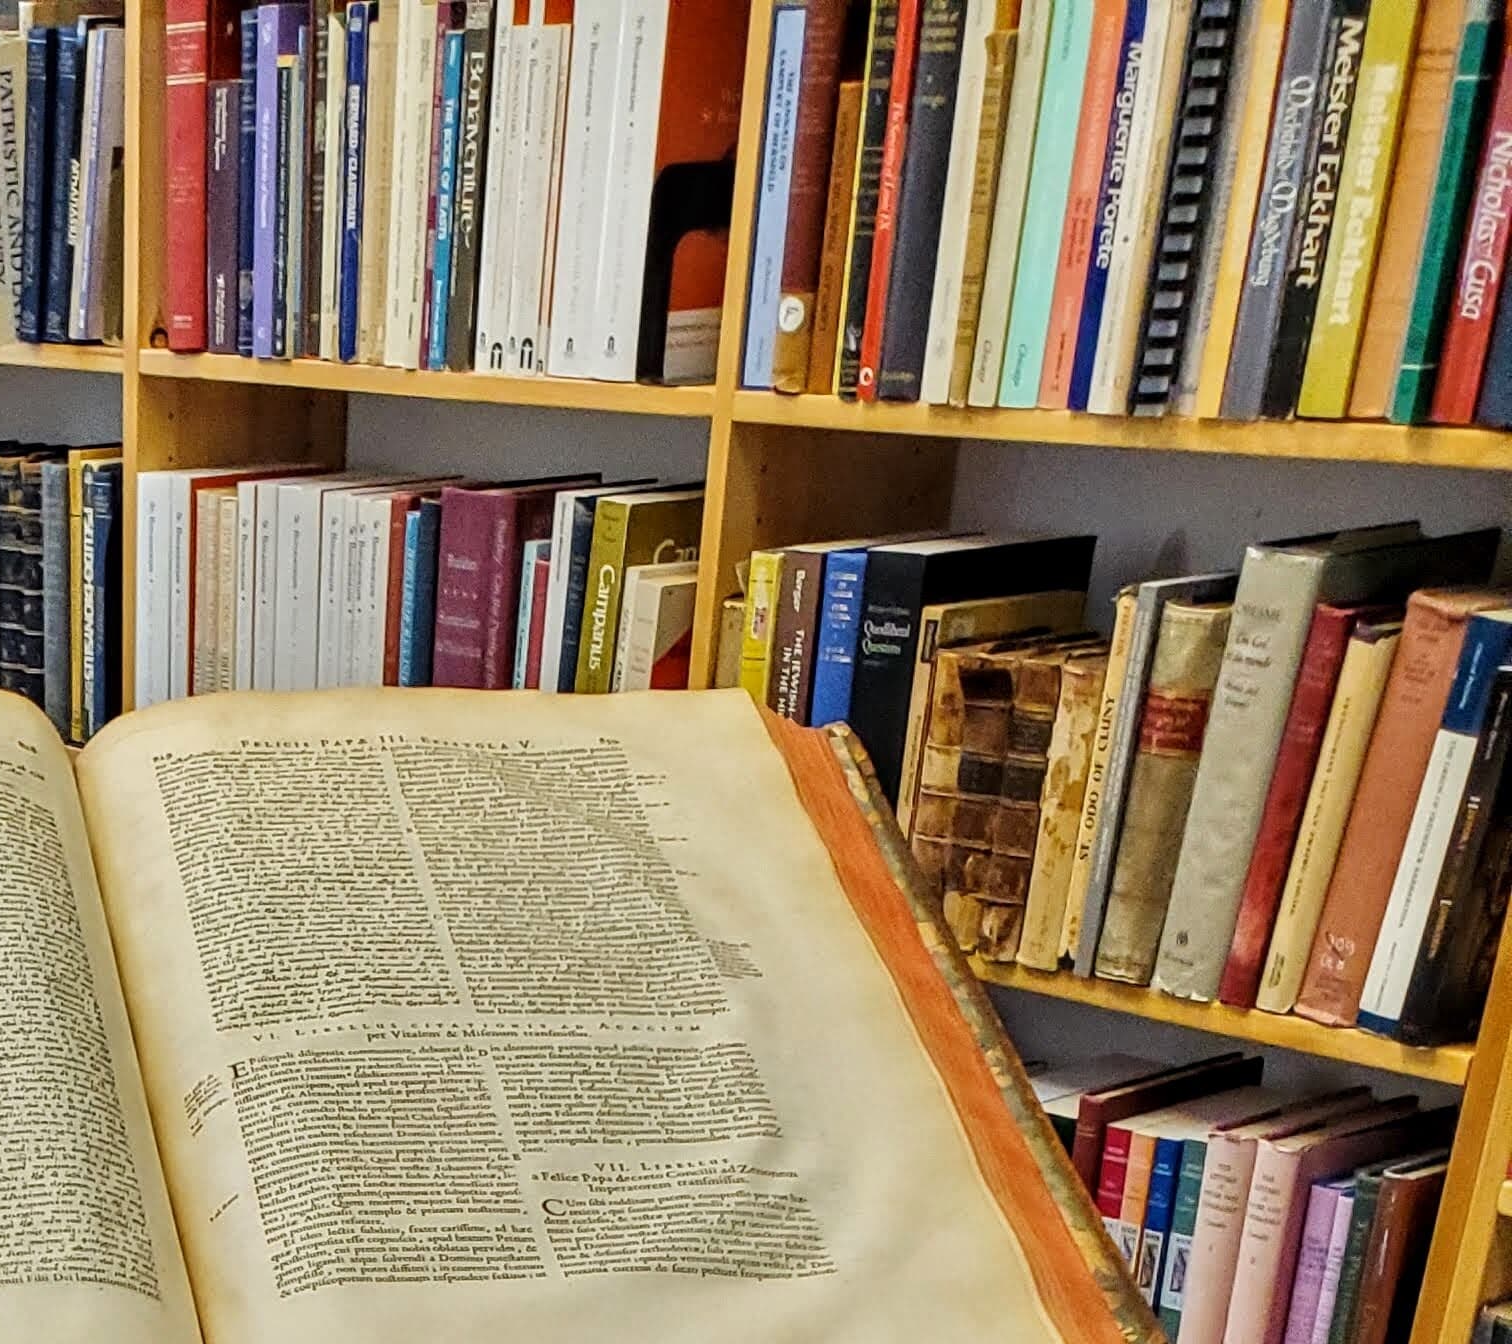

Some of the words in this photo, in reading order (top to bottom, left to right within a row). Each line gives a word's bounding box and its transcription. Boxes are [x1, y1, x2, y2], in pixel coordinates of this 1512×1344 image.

[1321, 18, 1364, 148] Meister
[444, 98, 454, 124] THE
[1354, 63, 1398, 188] Meister
[441, 127, 452, 168] BOOK
[462, 51, 486, 248] Bonaventure
[440, 170, 450, 190] OF
[437, 194, 449, 240] BEASTS
[1095, 188, 1123, 269] Porete
[1295, 153, 1339, 288] Eckhart
[7, 214, 24, 270] AND
[1329, 196, 1374, 326] Eckhart
[1461, 259, 1496, 320] Cusa
[793, 569, 806, 613] Berger
[588, 564, 616, 670] Campanus
[783, 647, 792, 662] IN
[795, 629, 805, 653] THE
[780, 664, 790, 689] THE
[1097, 693, 1116, 751] CLUNY
[1090, 761, 1105, 782] OF
[1082, 789, 1100, 829] ODO
[367, 1032, 386, 1042] per
[391, 1030, 441, 1039] Vitalem
[541, 1172, 579, 1182] Felice
[582, 1174, 613, 1184] Papa
[616, 1171, 663, 1183] decreto
[588, 1181, 672, 1195] Imperatorem
